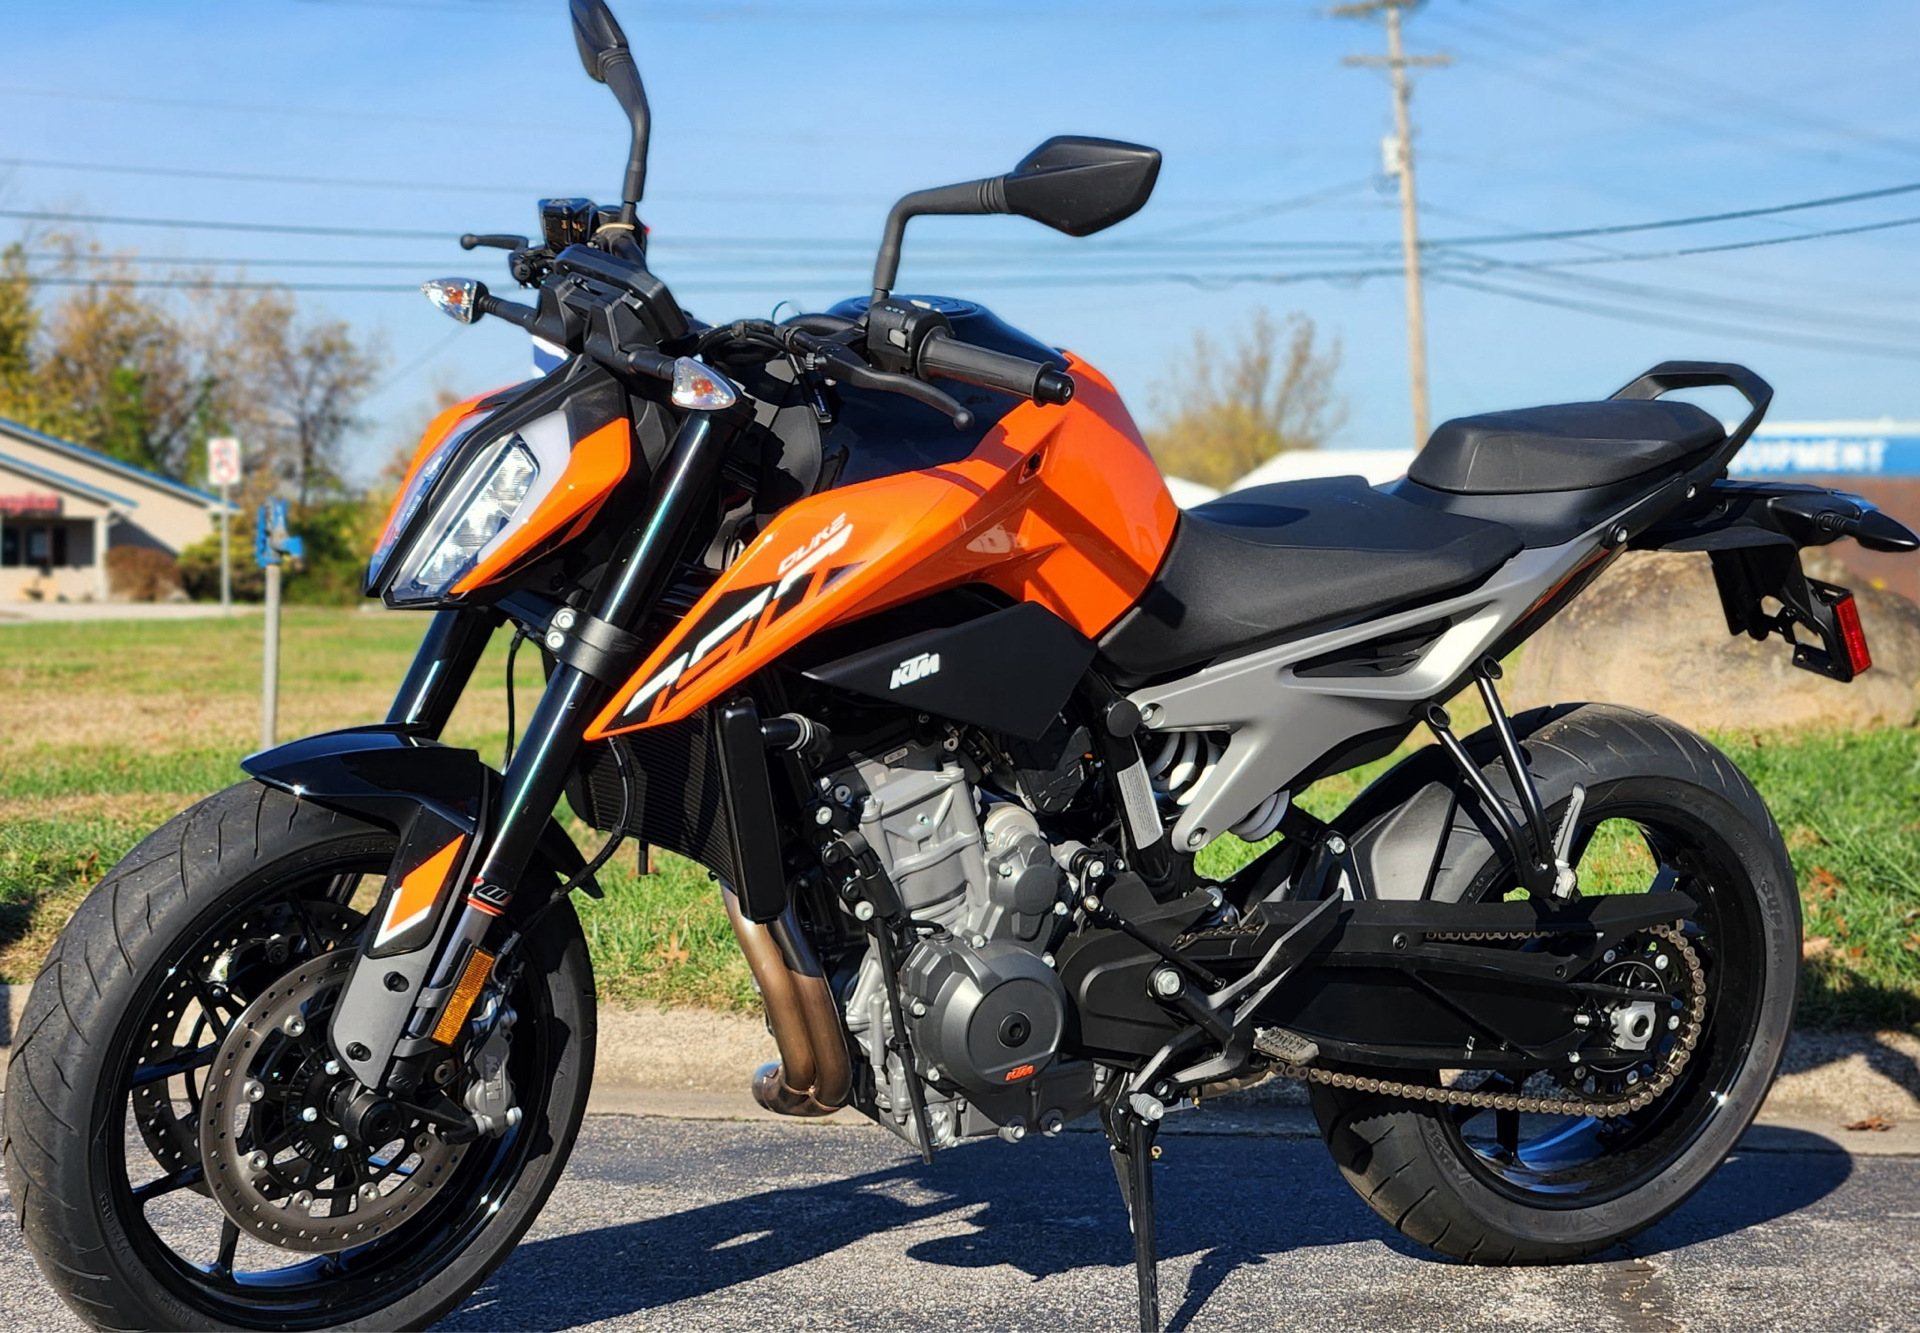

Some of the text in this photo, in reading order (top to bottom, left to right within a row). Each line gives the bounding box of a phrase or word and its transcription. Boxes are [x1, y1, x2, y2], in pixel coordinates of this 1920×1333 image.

[777, 512, 846, 576] DUKE
[889, 652, 940, 690] KTM
[1005, 1065, 1034, 1081] KTM
